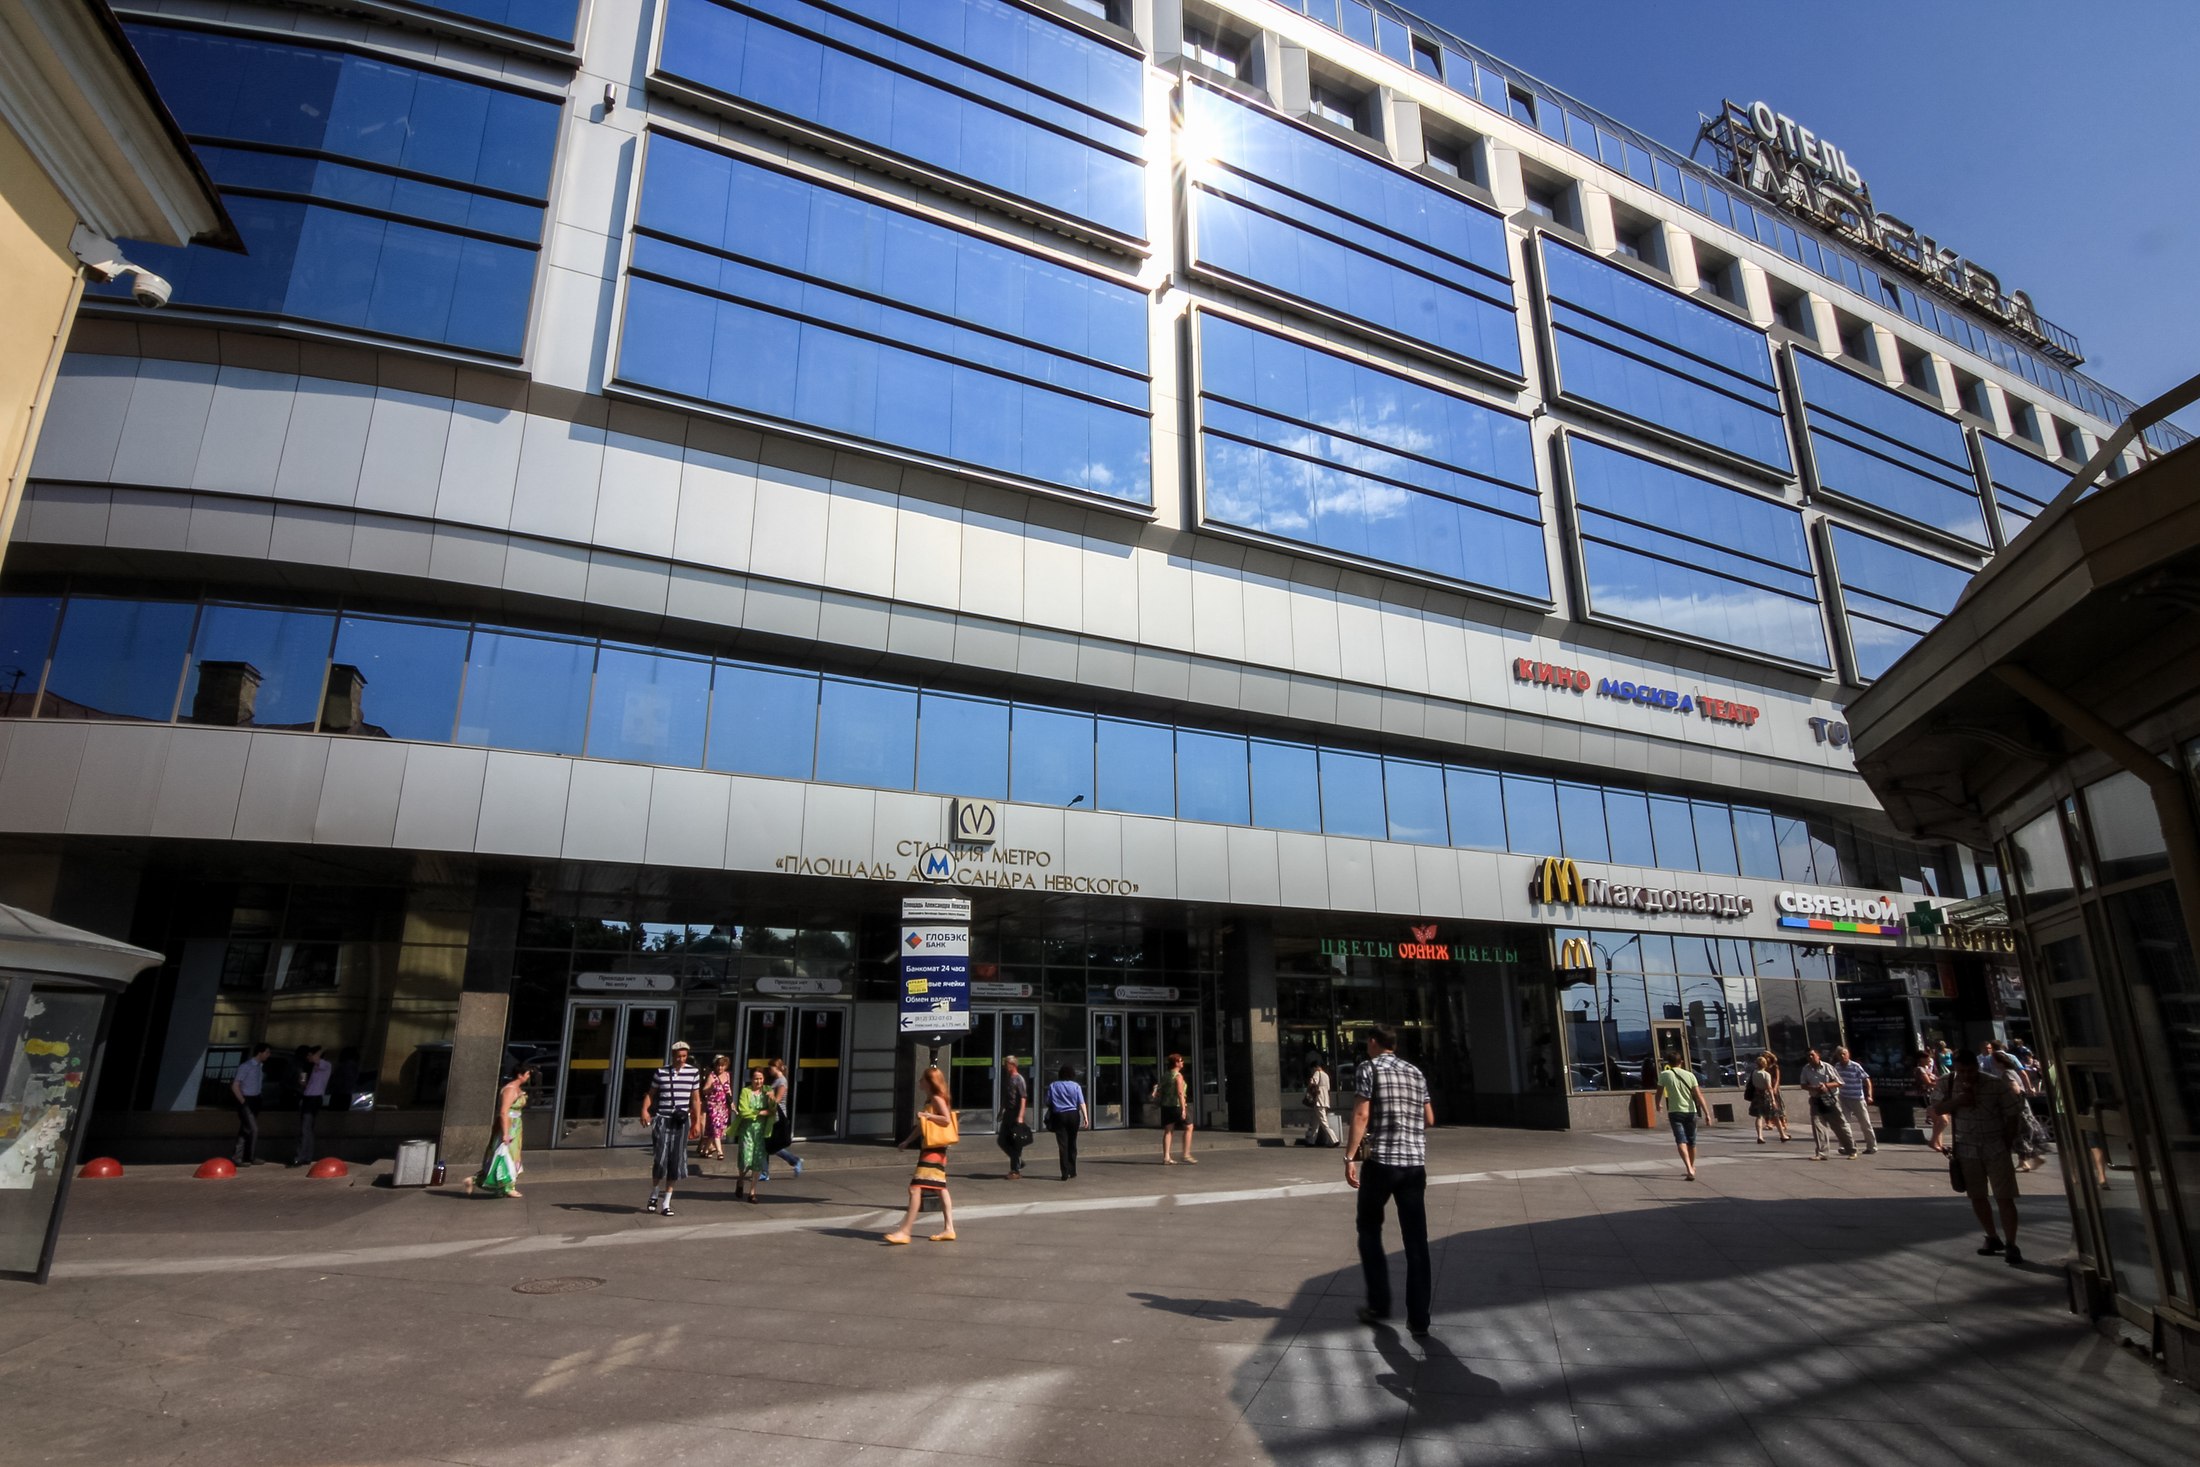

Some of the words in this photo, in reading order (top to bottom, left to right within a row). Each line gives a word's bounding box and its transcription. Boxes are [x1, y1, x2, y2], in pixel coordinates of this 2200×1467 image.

[1747, 100, 1862, 193] ОТЕЛЬ
[1513, 656, 1591, 693] КИНО
[1597, 676, 1694, 714] МОСКВА
[1696, 694, 1760, 727] ТЕАТР
[1809, 717, 1861, 750] ТО
[992, 847, 1051, 867] МЕТРО
[775, 855, 897, 880] «ПЛОЩАДЬ
[906, 864, 1037, 890] АСАНДРА
[1044, 874, 1140, 896] НЕВСКОГО»
[1582, 877, 1753, 919] Макдоналдс
[1776, 889, 1900, 922] СВЯЗНОЙ
[926, 933, 967, 942] ГЛОБЭКС
[1320, 938, 1393, 958] ЦВЕТЫ
[1399, 943, 1450, 961] ОРАНЖ
[1454, 945, 1519, 964] ЦВЕТЫ
